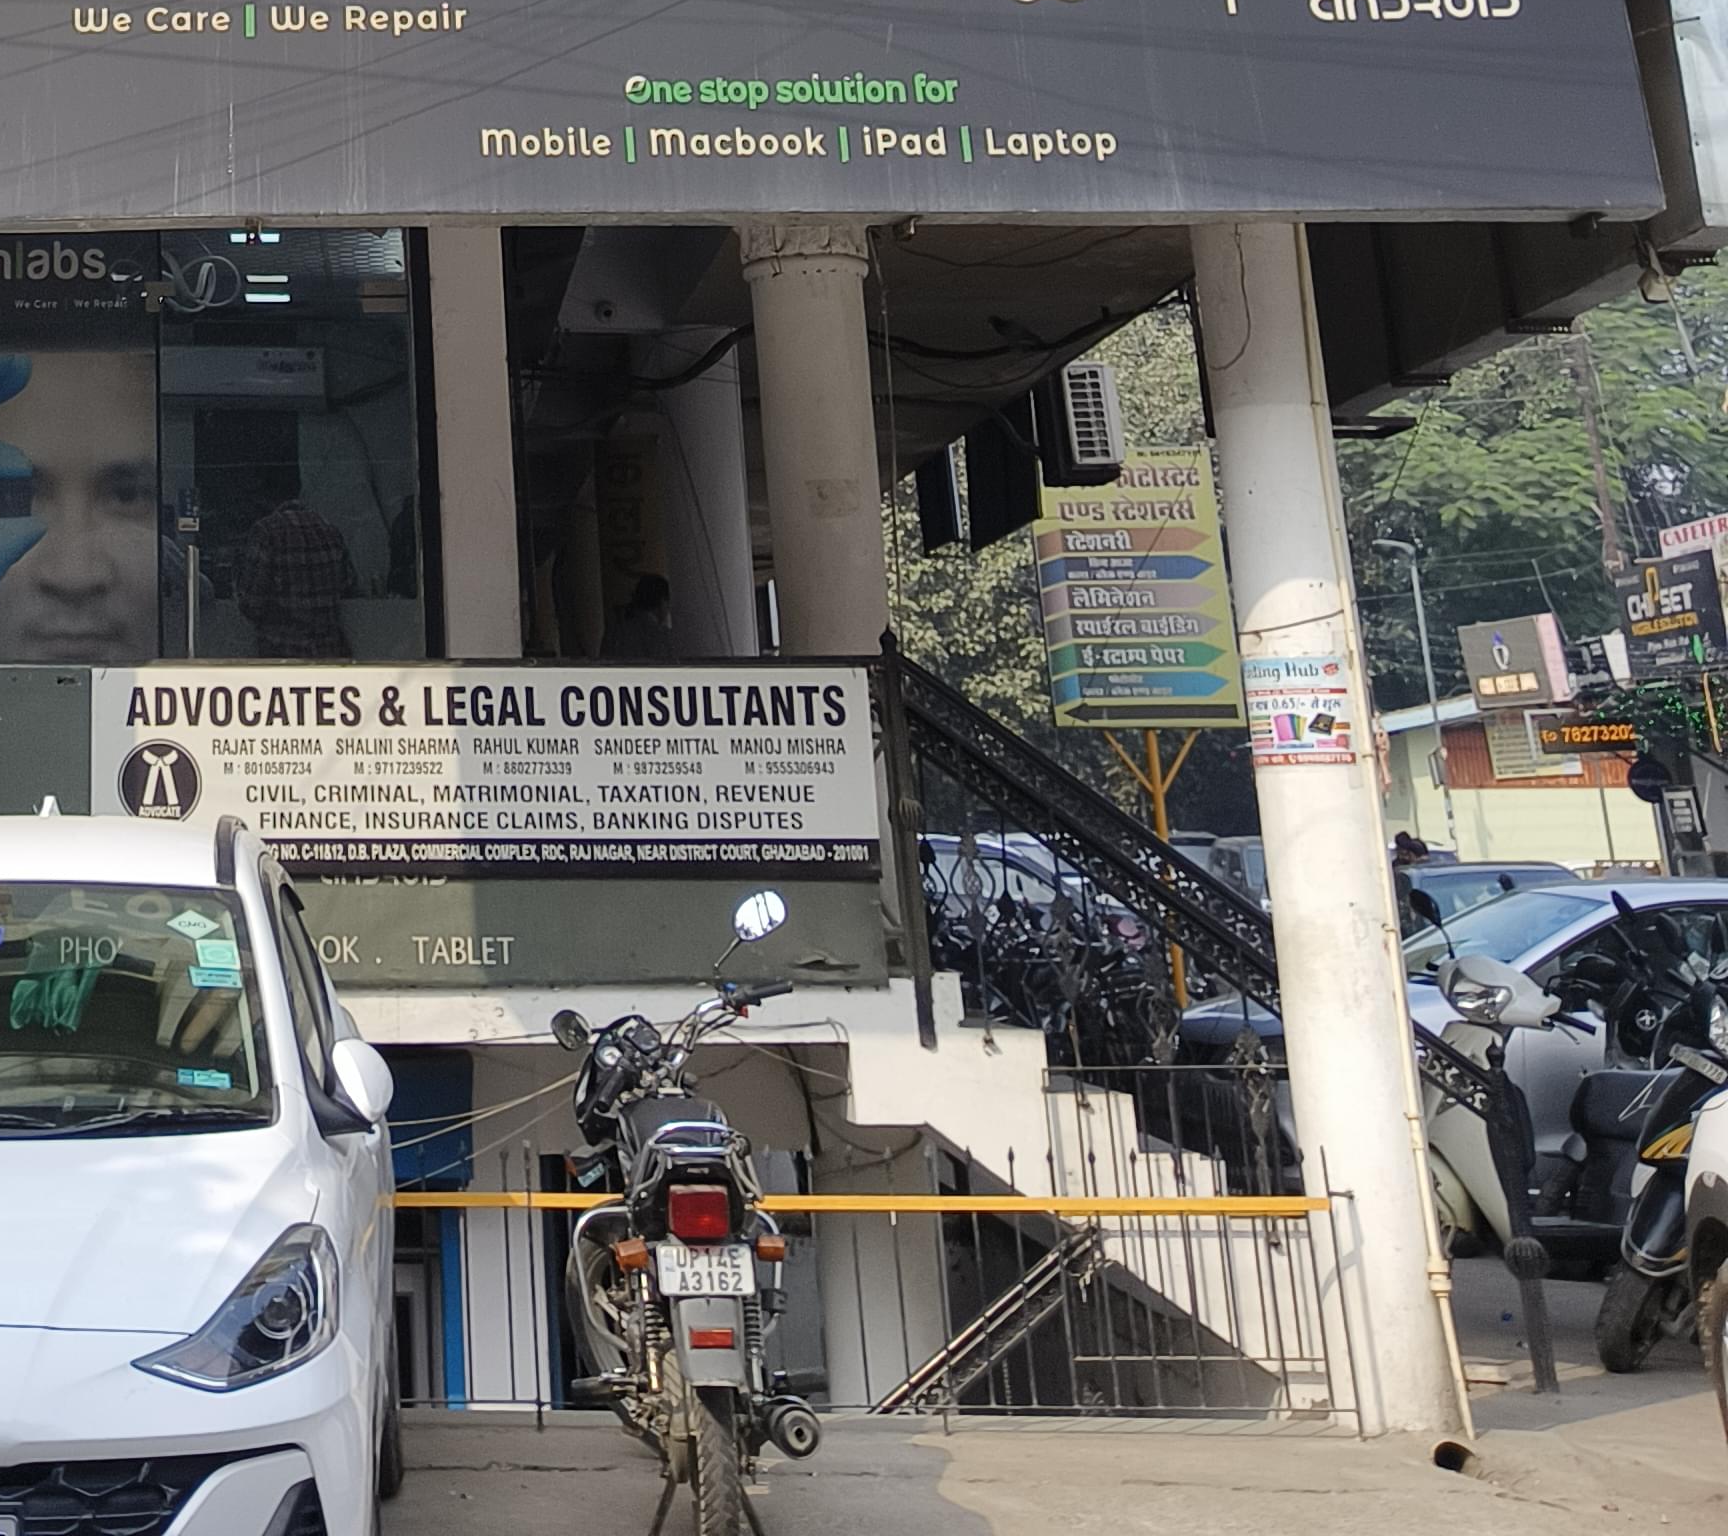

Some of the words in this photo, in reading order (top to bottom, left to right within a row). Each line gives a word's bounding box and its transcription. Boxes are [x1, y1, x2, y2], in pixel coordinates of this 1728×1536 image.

[73, 6, 133, 34] We
[146, 5, 230, 33] Care
[271, 5, 329, 33] We
[345, 1, 468, 36] Repair
[625, 74, 693, 105] One
[700, 76, 769, 109] stop
[775, 71, 906, 105] solution
[914, 72, 958, 104] for
[480, 126, 612, 157] Mobile
[649, 125, 826, 158] Macbook
[862, 126, 948, 158] iPad
[985, 127, 1118, 163] Laptop
[126, 686, 362, 728] ADVOCATES
[378, 686, 406, 727] &
[424, 686, 545, 727] LEGAL
[560, 685, 847, 727] CONSULTANTS
[212, 738, 255, 756] RAJAT
[260, 738, 323, 756] SHARMA
[335, 738, 394, 756] SHALINI
[398, 738, 461, 756] SHARMA
[473, 737, 522, 756] RAHUL
[526, 737, 579, 756] KUMAR
[594, 737, 661, 756] SANDEEP
[667, 737, 719, 756] MITTAL
[730, 737, 782, 756] MANOJ
[788, 737, 846, 756] MISHRA
[246, 784, 306, 805] CIVIL,
[314, 784, 425, 805] CRIMINAL,
[433, 784, 591, 805] MATRIMONIAL,
[597, 784, 708, 805] TAXATION,
[716, 784, 815, 803] REVENUE
[260, 811, 357, 832] FINANCE,
[365, 811, 488, 829] INSURANCE
[497, 811, 586, 832] CLAIMS,
[593, 811, 688, 830] BANKING
[697, 811, 804, 830] DISPUTES
[412, 936, 515, 965] TABLET
[679, 1271, 744, 1292] A3162
